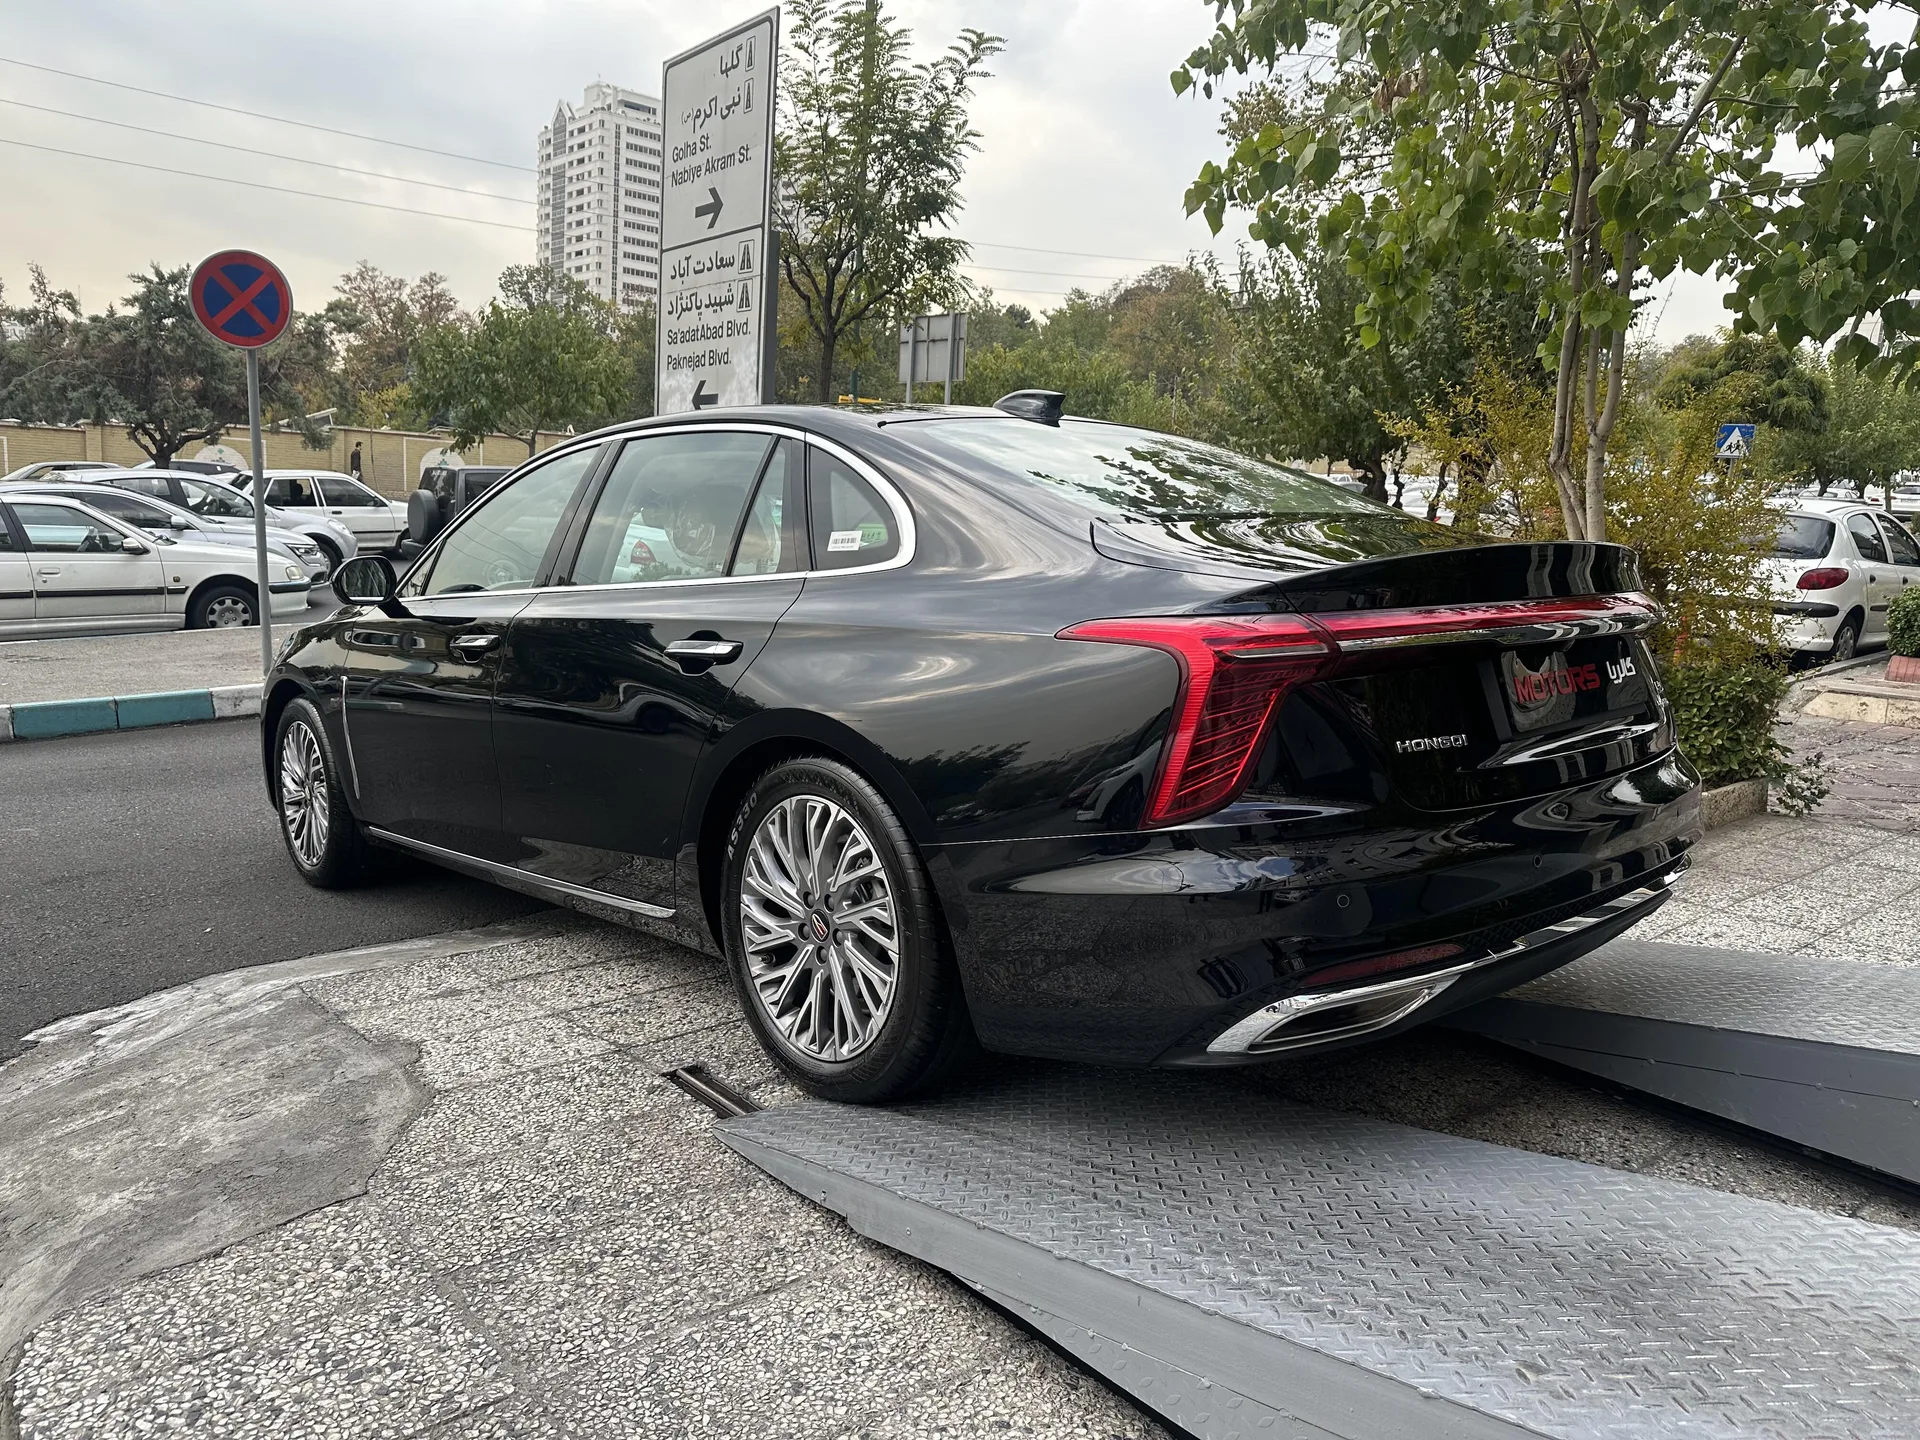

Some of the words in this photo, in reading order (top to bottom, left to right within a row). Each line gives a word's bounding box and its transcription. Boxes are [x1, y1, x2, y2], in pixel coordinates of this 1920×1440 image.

[720, 43, 743, 79] گلها
[720, 86, 741, 120] نبی
[672, 140, 697, 163] Golha
[699, 133, 712, 154] St.
[671, 163, 702, 188] Nabiye
[704, 152, 736, 177] Akram
[738, 144, 752, 164] St.
[670, 254, 692, 285] آباد
[693, 250, 735, 275] سعادت
[667, 291, 703, 321] پاکنژاد
[705, 283, 735, 314] شهید
[726, 317, 751, 339] Blvd.
[667, 349, 706, 372] Paknejad
[708, 347, 732, 366] Blvd.
[1513, 663, 1600, 704] MOTORS
[1396, 734, 1469, 753] HONGQI
[727, 792, 758, 861] AS330
